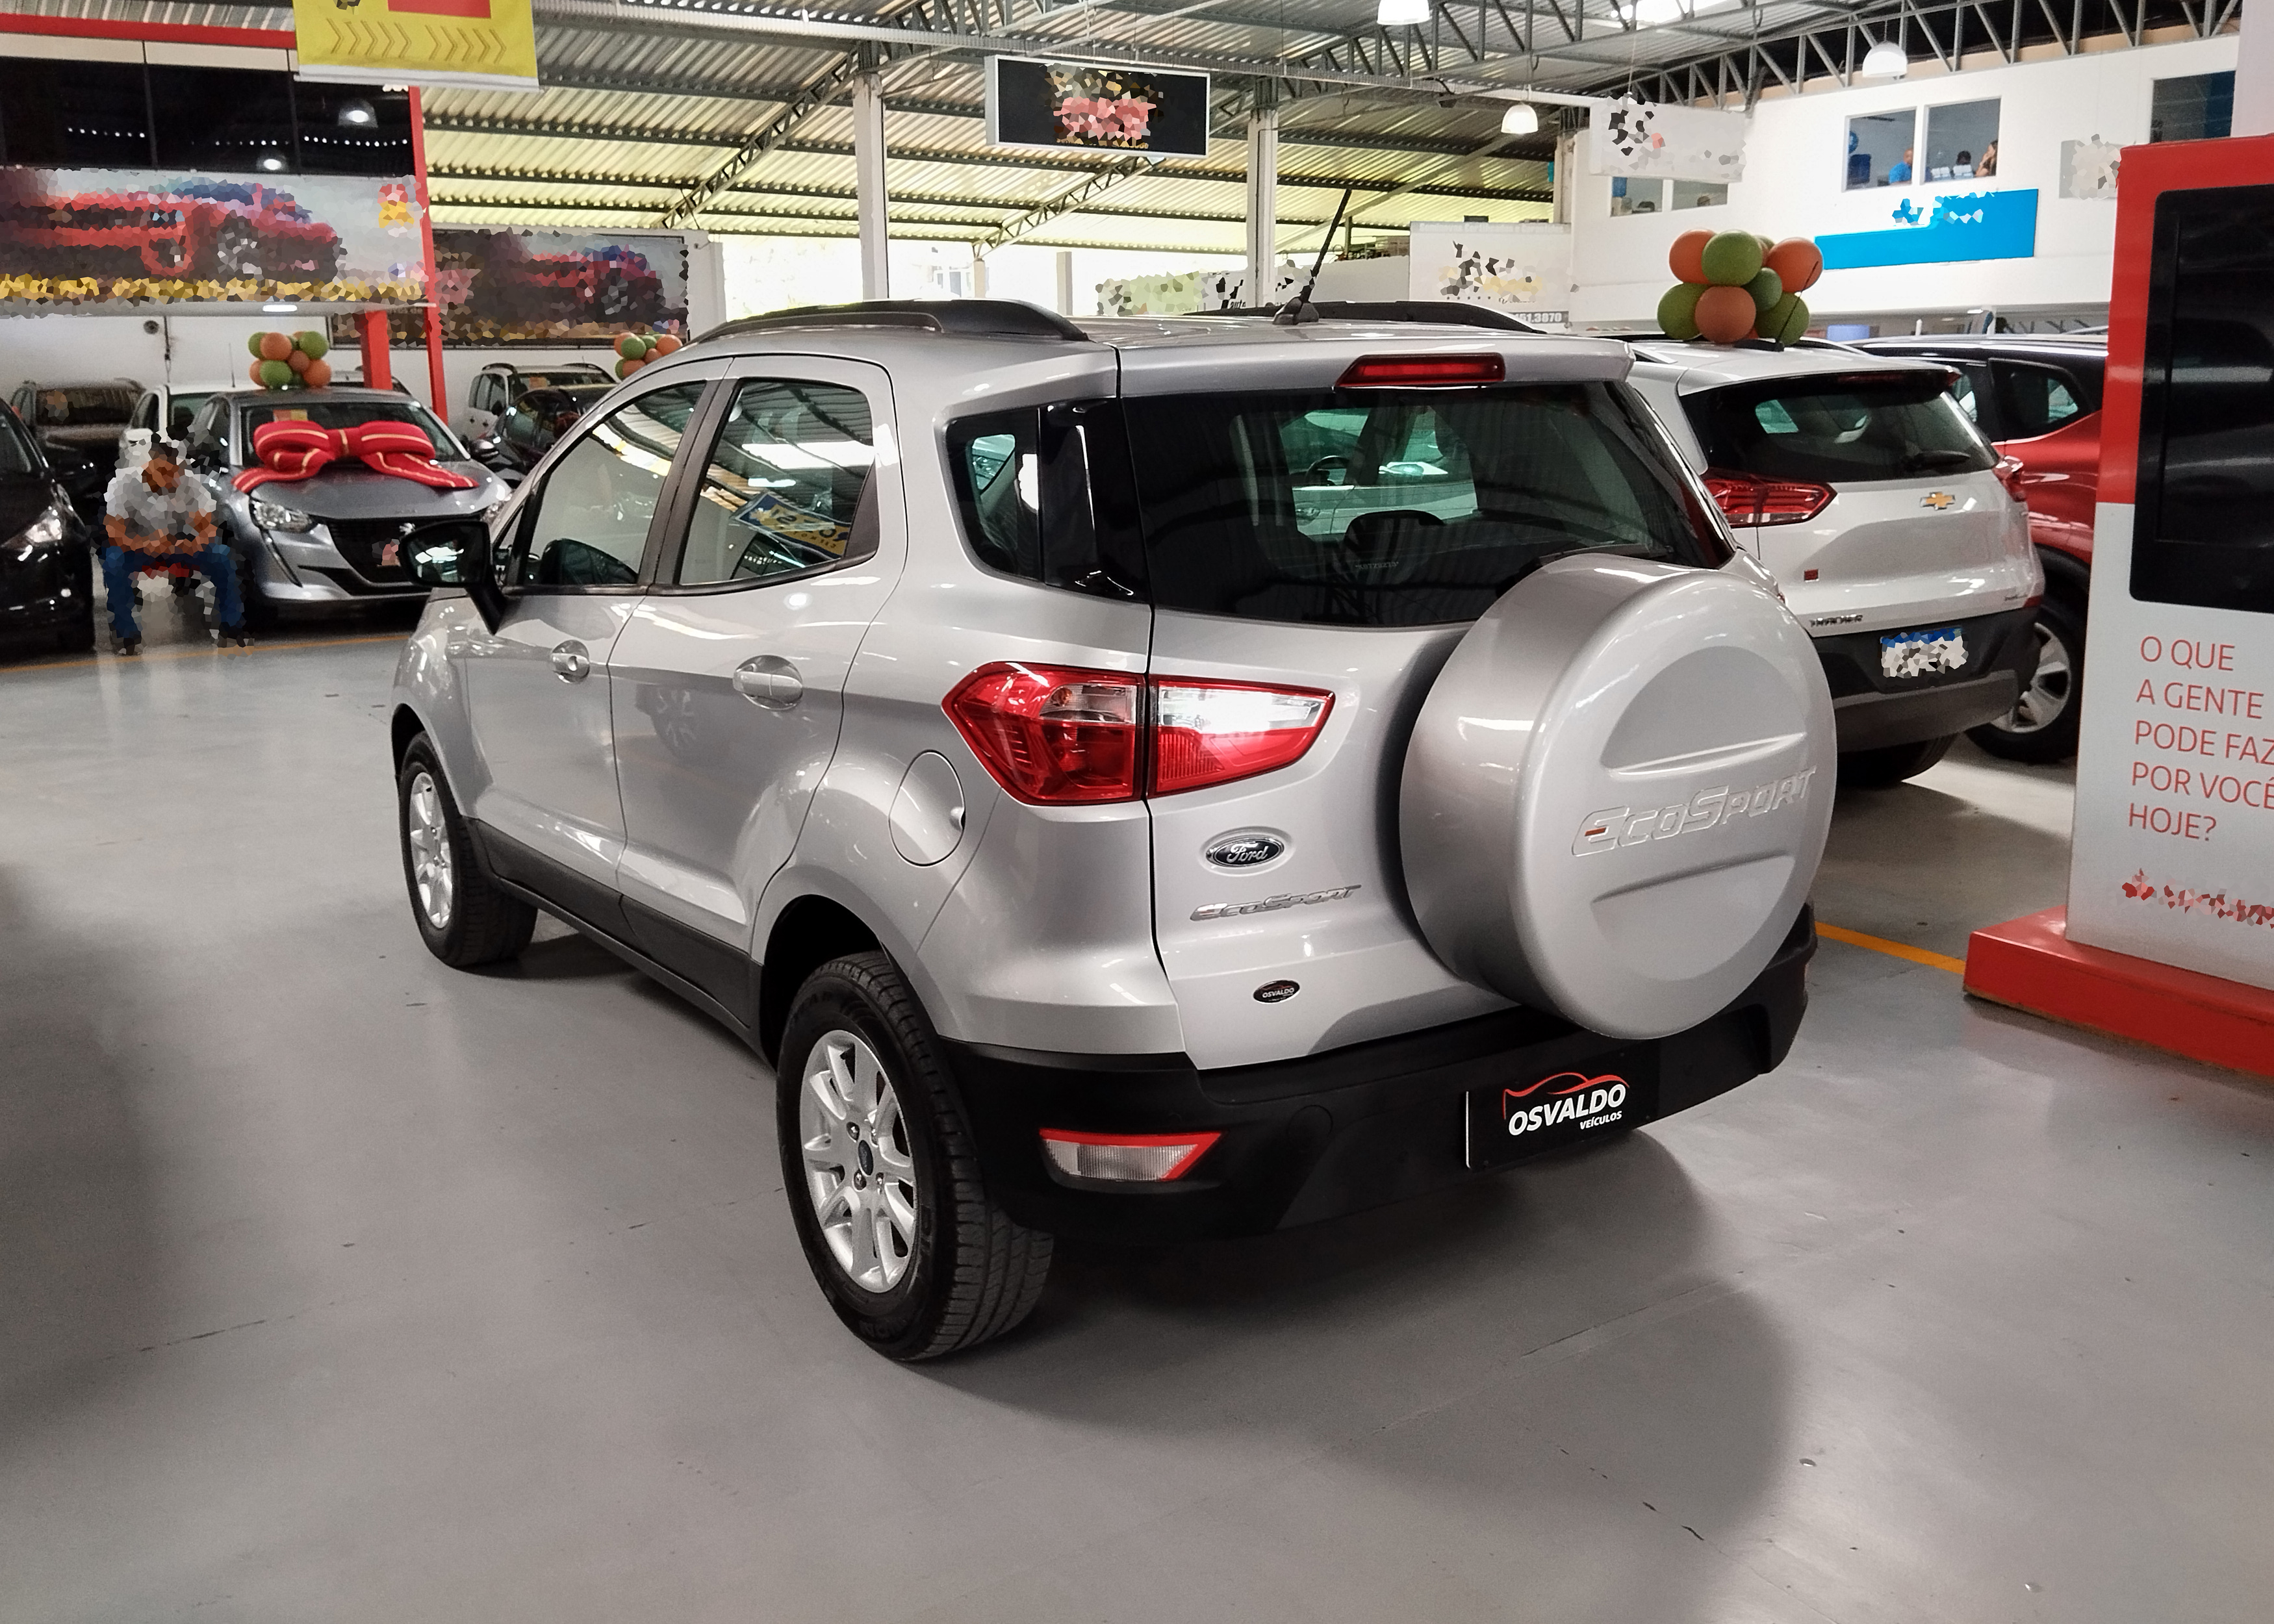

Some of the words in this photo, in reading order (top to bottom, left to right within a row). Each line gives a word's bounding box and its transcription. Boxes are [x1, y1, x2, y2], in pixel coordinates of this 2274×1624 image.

[2140, 636, 2162, 662] O
[2171, 639, 2235, 671] QUE
[2136, 679, 2156, 705] A
[2164, 682, 2264, 719] GENTE
[2136, 720, 2217, 756] PODE
[2132, 761, 2191, 796] POR
[2199, 772, 2274, 810] VOCÊ
[2128, 803, 2217, 841] HOJE?
[1227, 841, 1270, 863] Ford
[1262, 987, 1295, 998] OSVALDO
[1509, 1084, 1626, 1136] OSVALDO
[1580, 1110, 1622, 1130] VEÍCULOS
